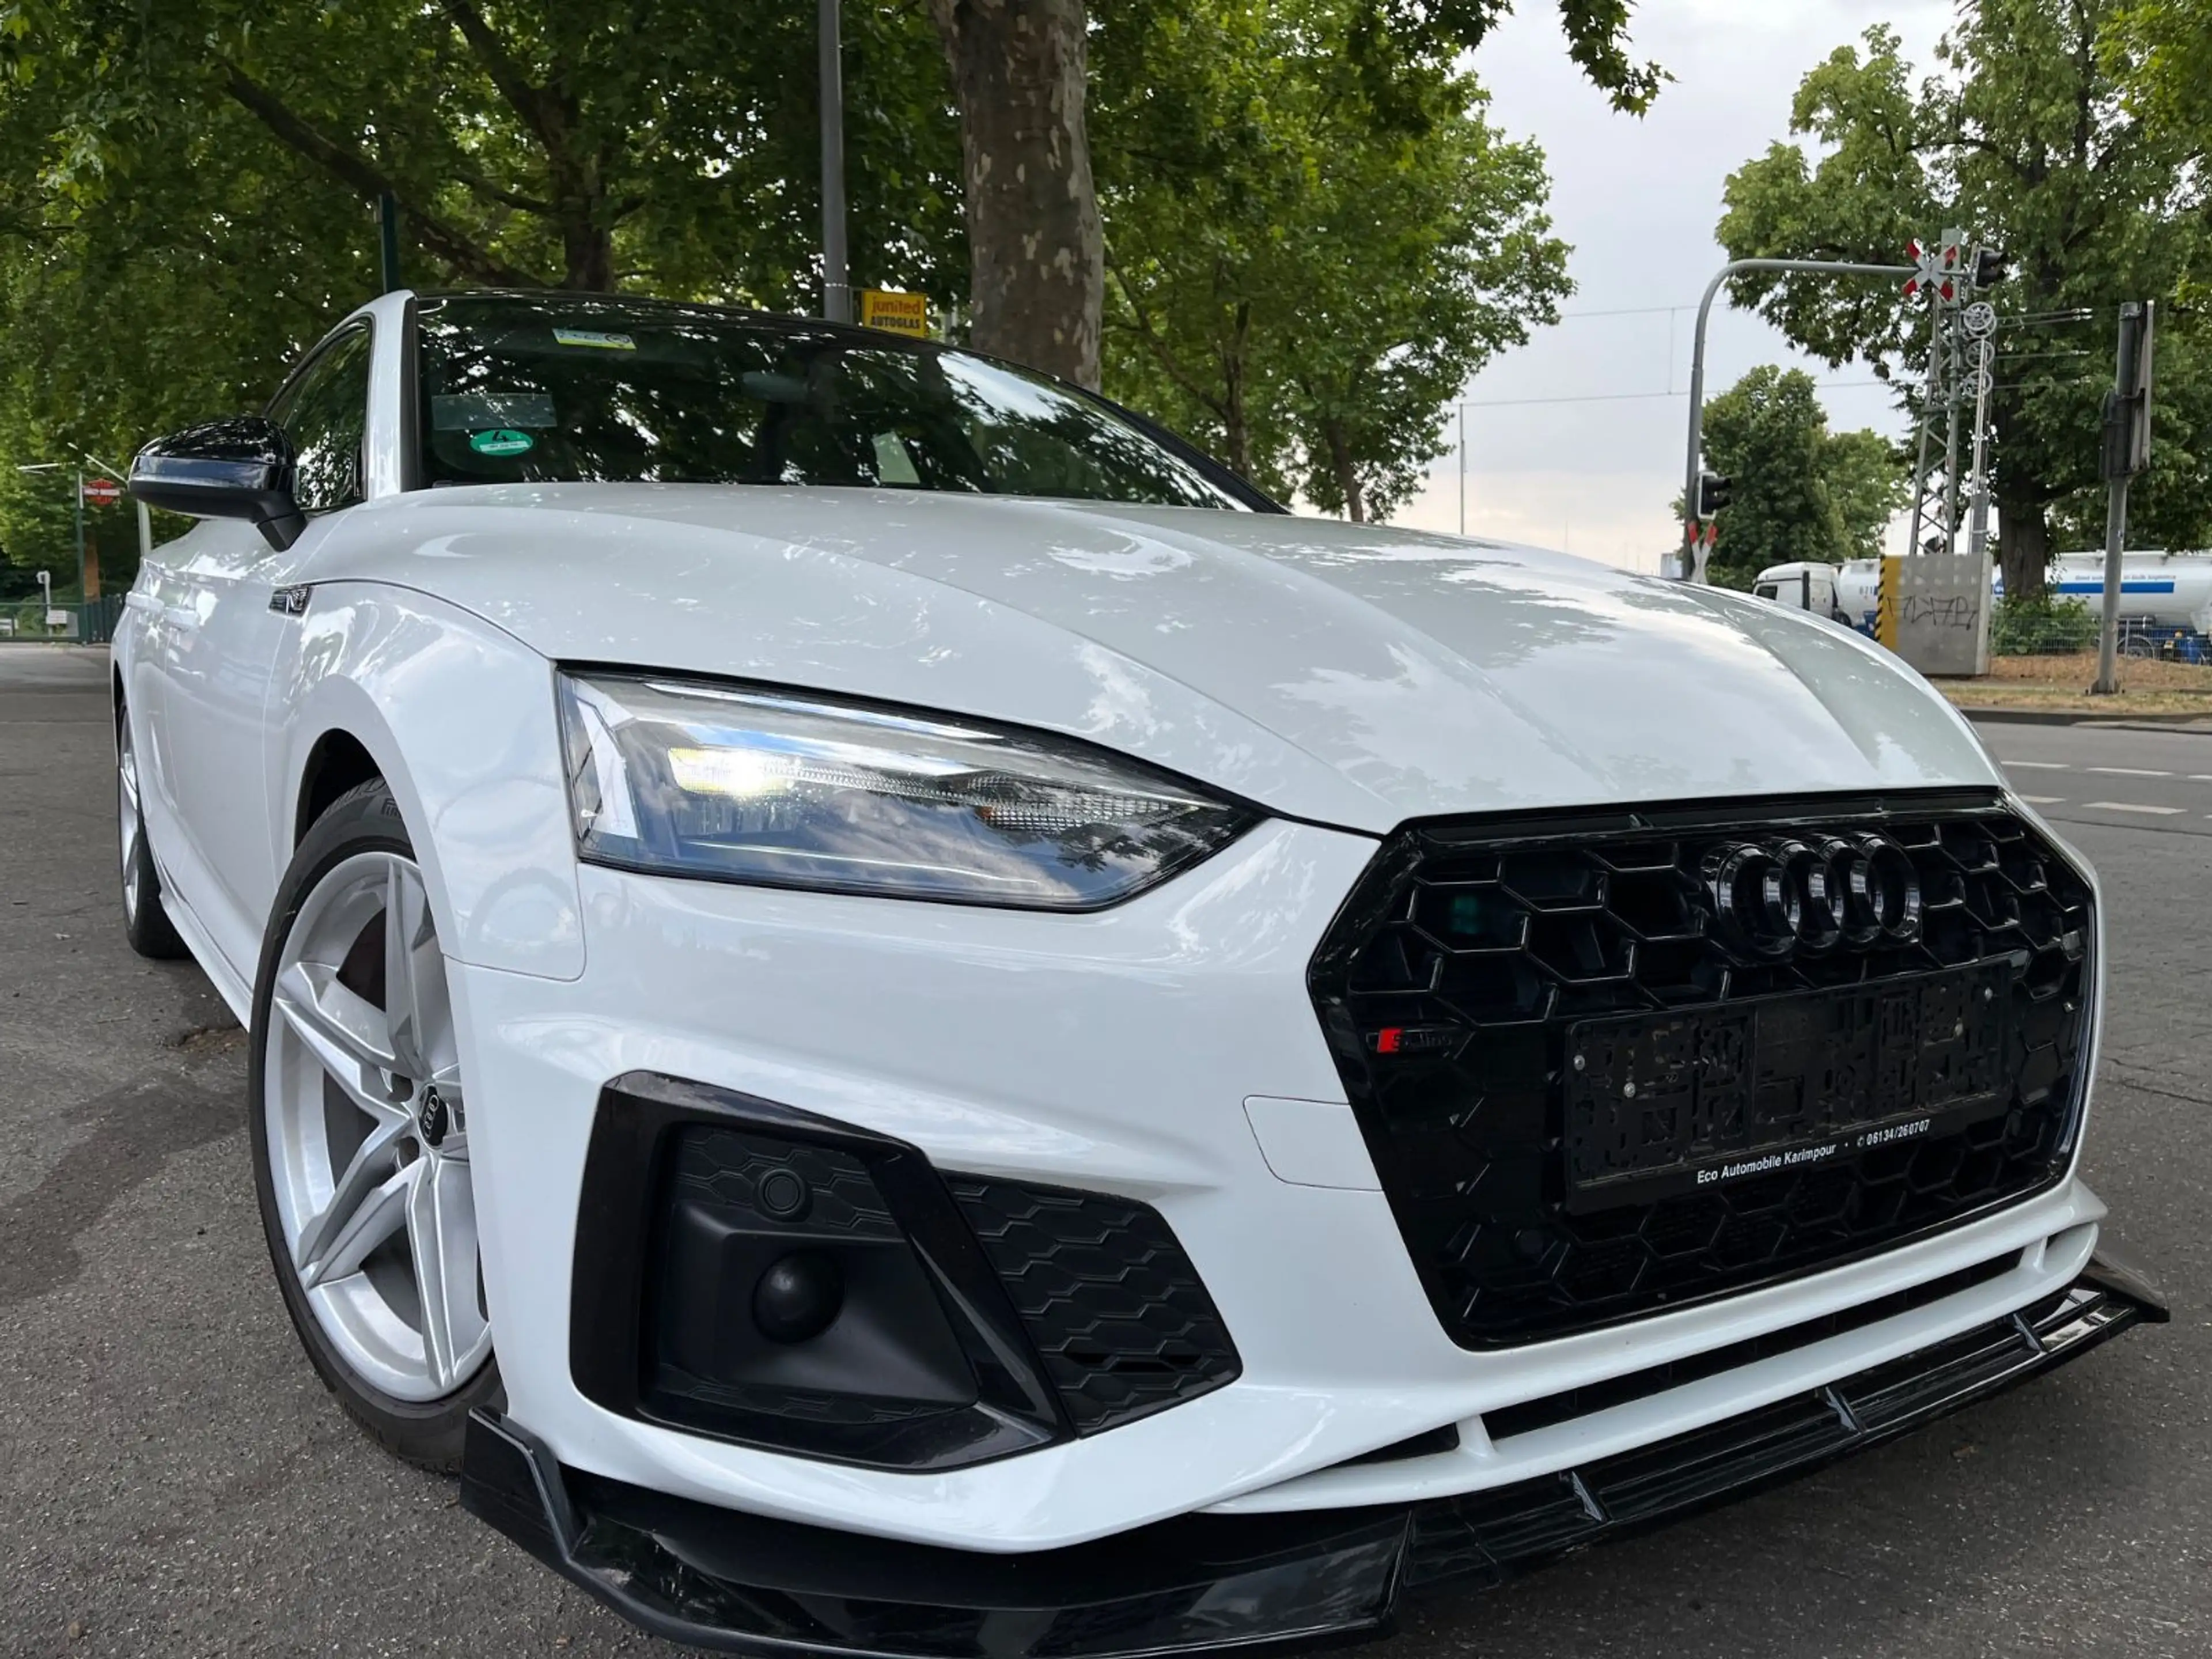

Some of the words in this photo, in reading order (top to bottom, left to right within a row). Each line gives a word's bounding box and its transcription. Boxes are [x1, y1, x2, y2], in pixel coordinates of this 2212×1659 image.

[872, 296, 920, 314] junited
[1697, 1169, 1718, 1184] Eco
[1721, 1155, 1782, 1179] Automobile
[1785, 1144, 1836, 1165] Karimpour
[1866, 1119, 1930, 1146] 06134/260707
